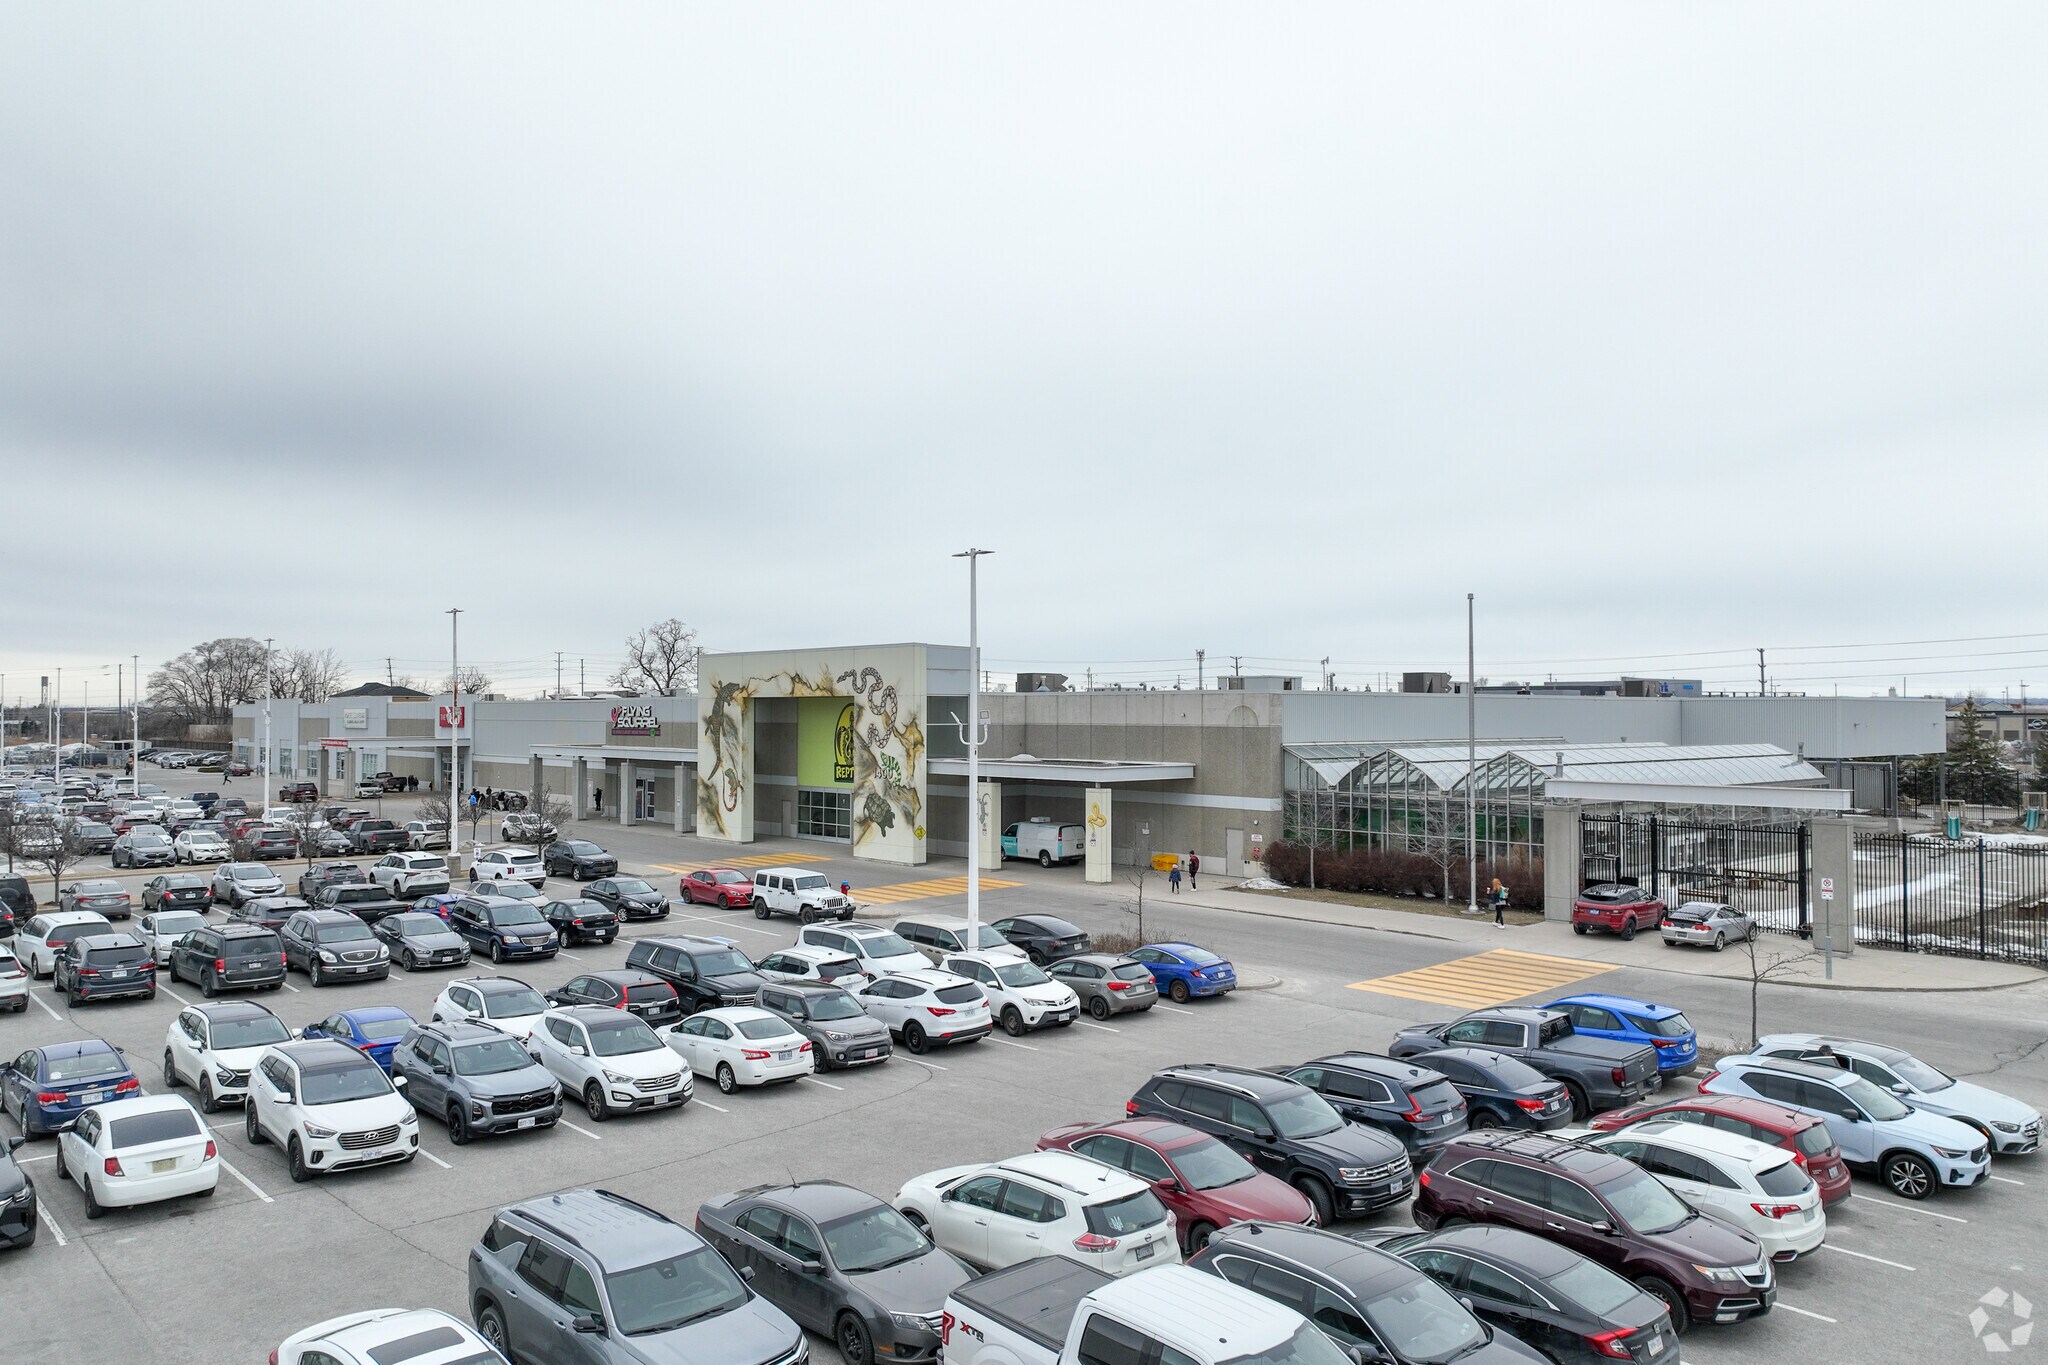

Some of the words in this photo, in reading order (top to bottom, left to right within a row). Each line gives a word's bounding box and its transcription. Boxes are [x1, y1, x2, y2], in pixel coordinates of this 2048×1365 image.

[621, 706, 652, 717] FLYING
[617, 717, 660, 728] SQUIRREL
[873, 768, 893, 779] 1400
[960, 1320, 984, 1343] XTR
